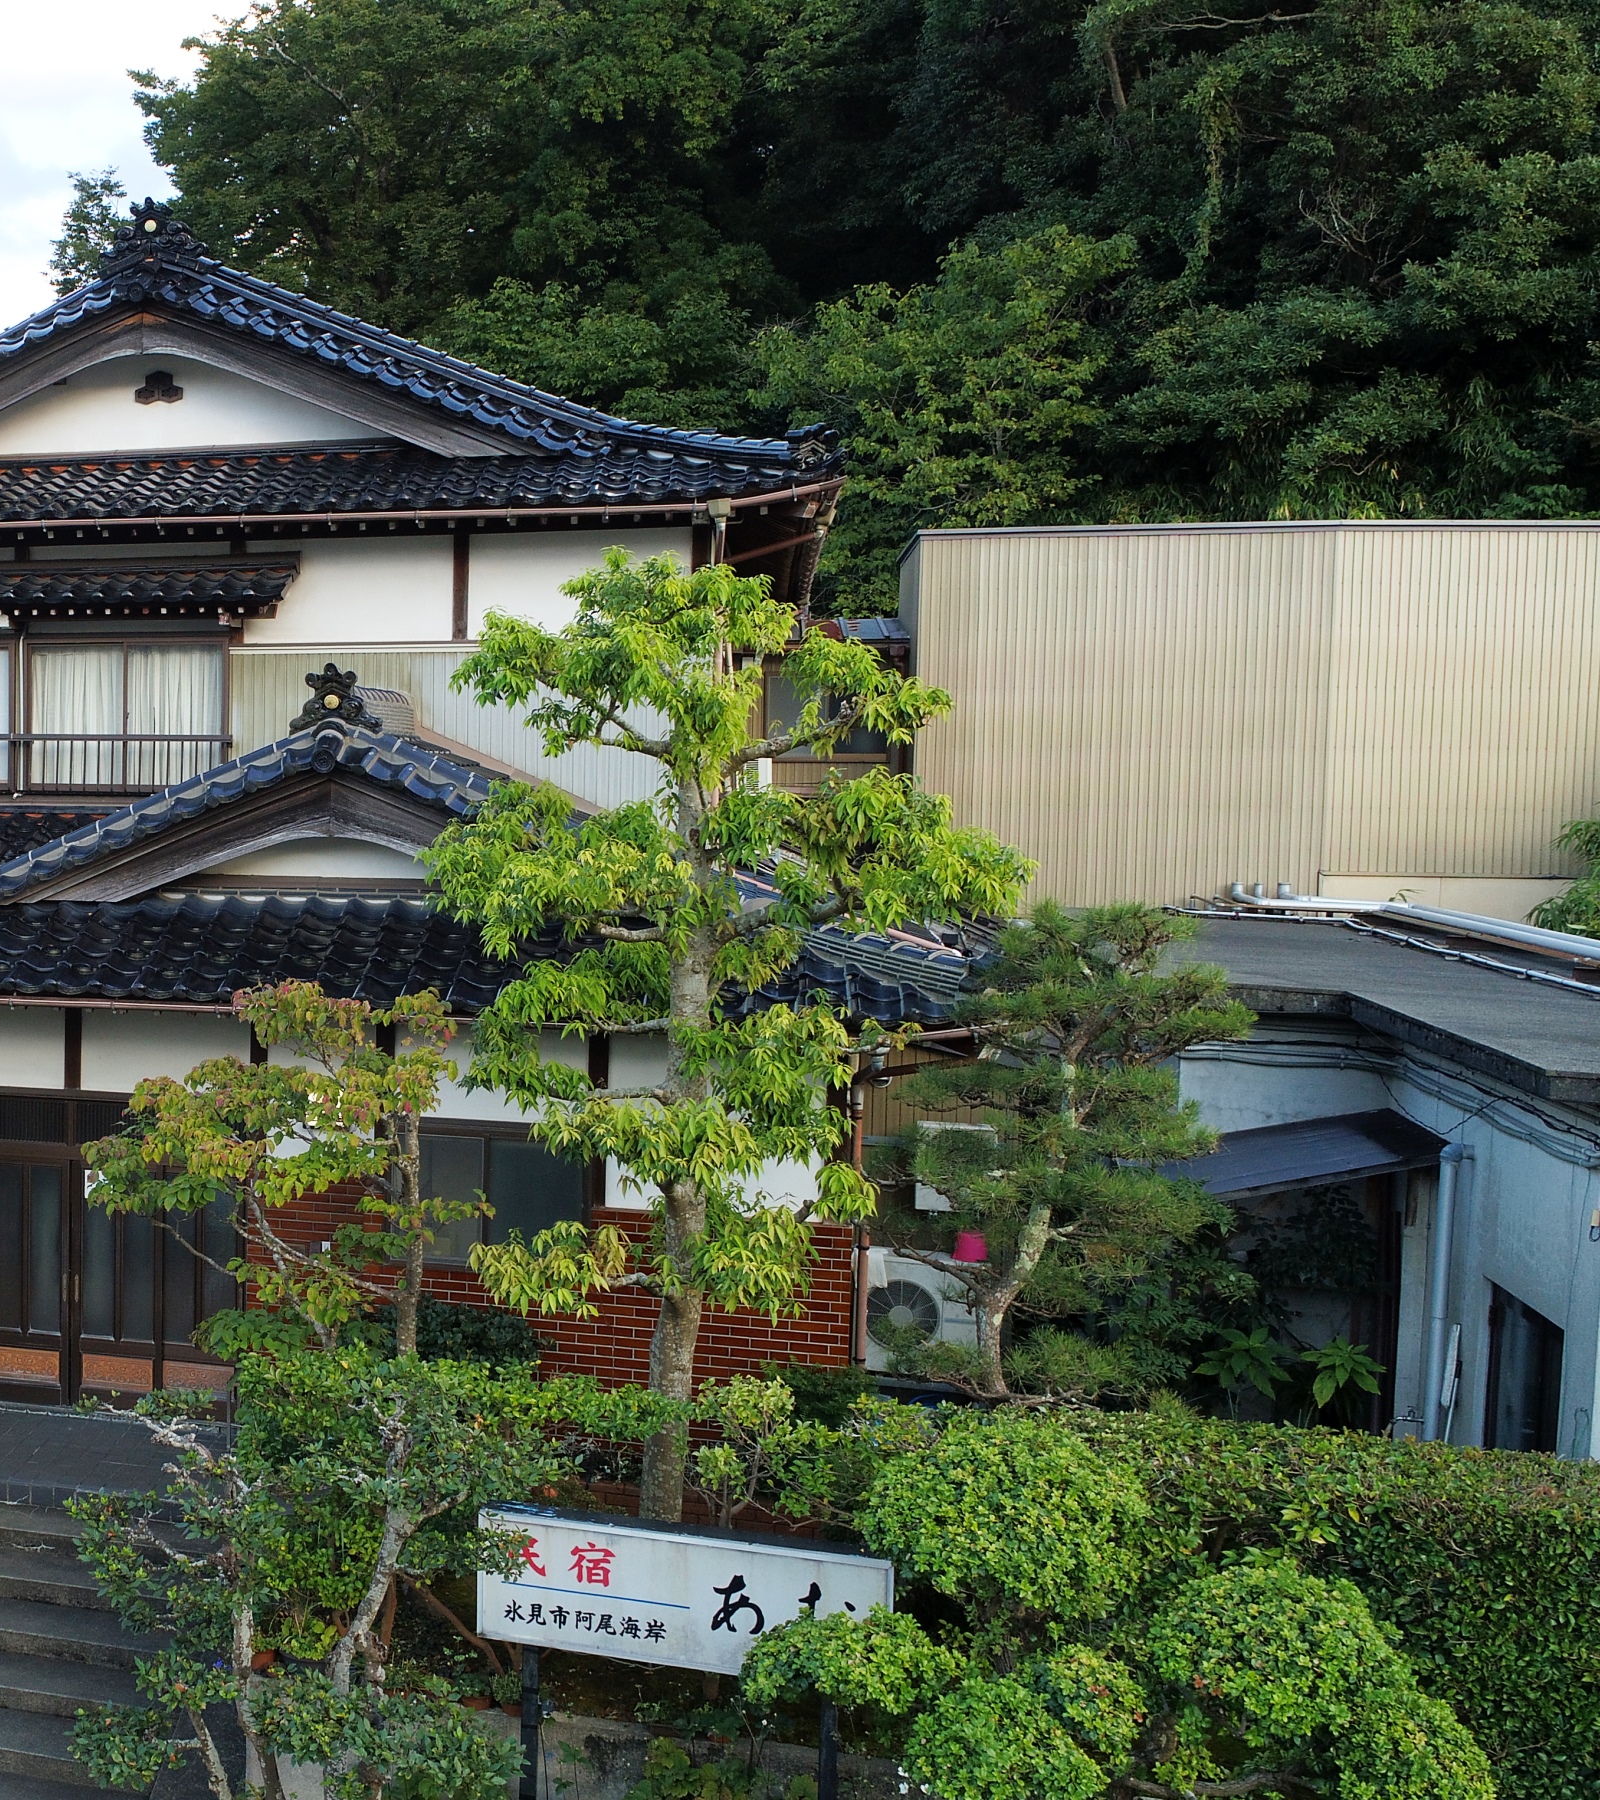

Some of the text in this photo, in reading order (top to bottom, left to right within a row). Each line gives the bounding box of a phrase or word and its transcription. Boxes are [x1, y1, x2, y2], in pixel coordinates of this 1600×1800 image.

[503, 1598, 667, 1643] 氷見市阿尾海岸
